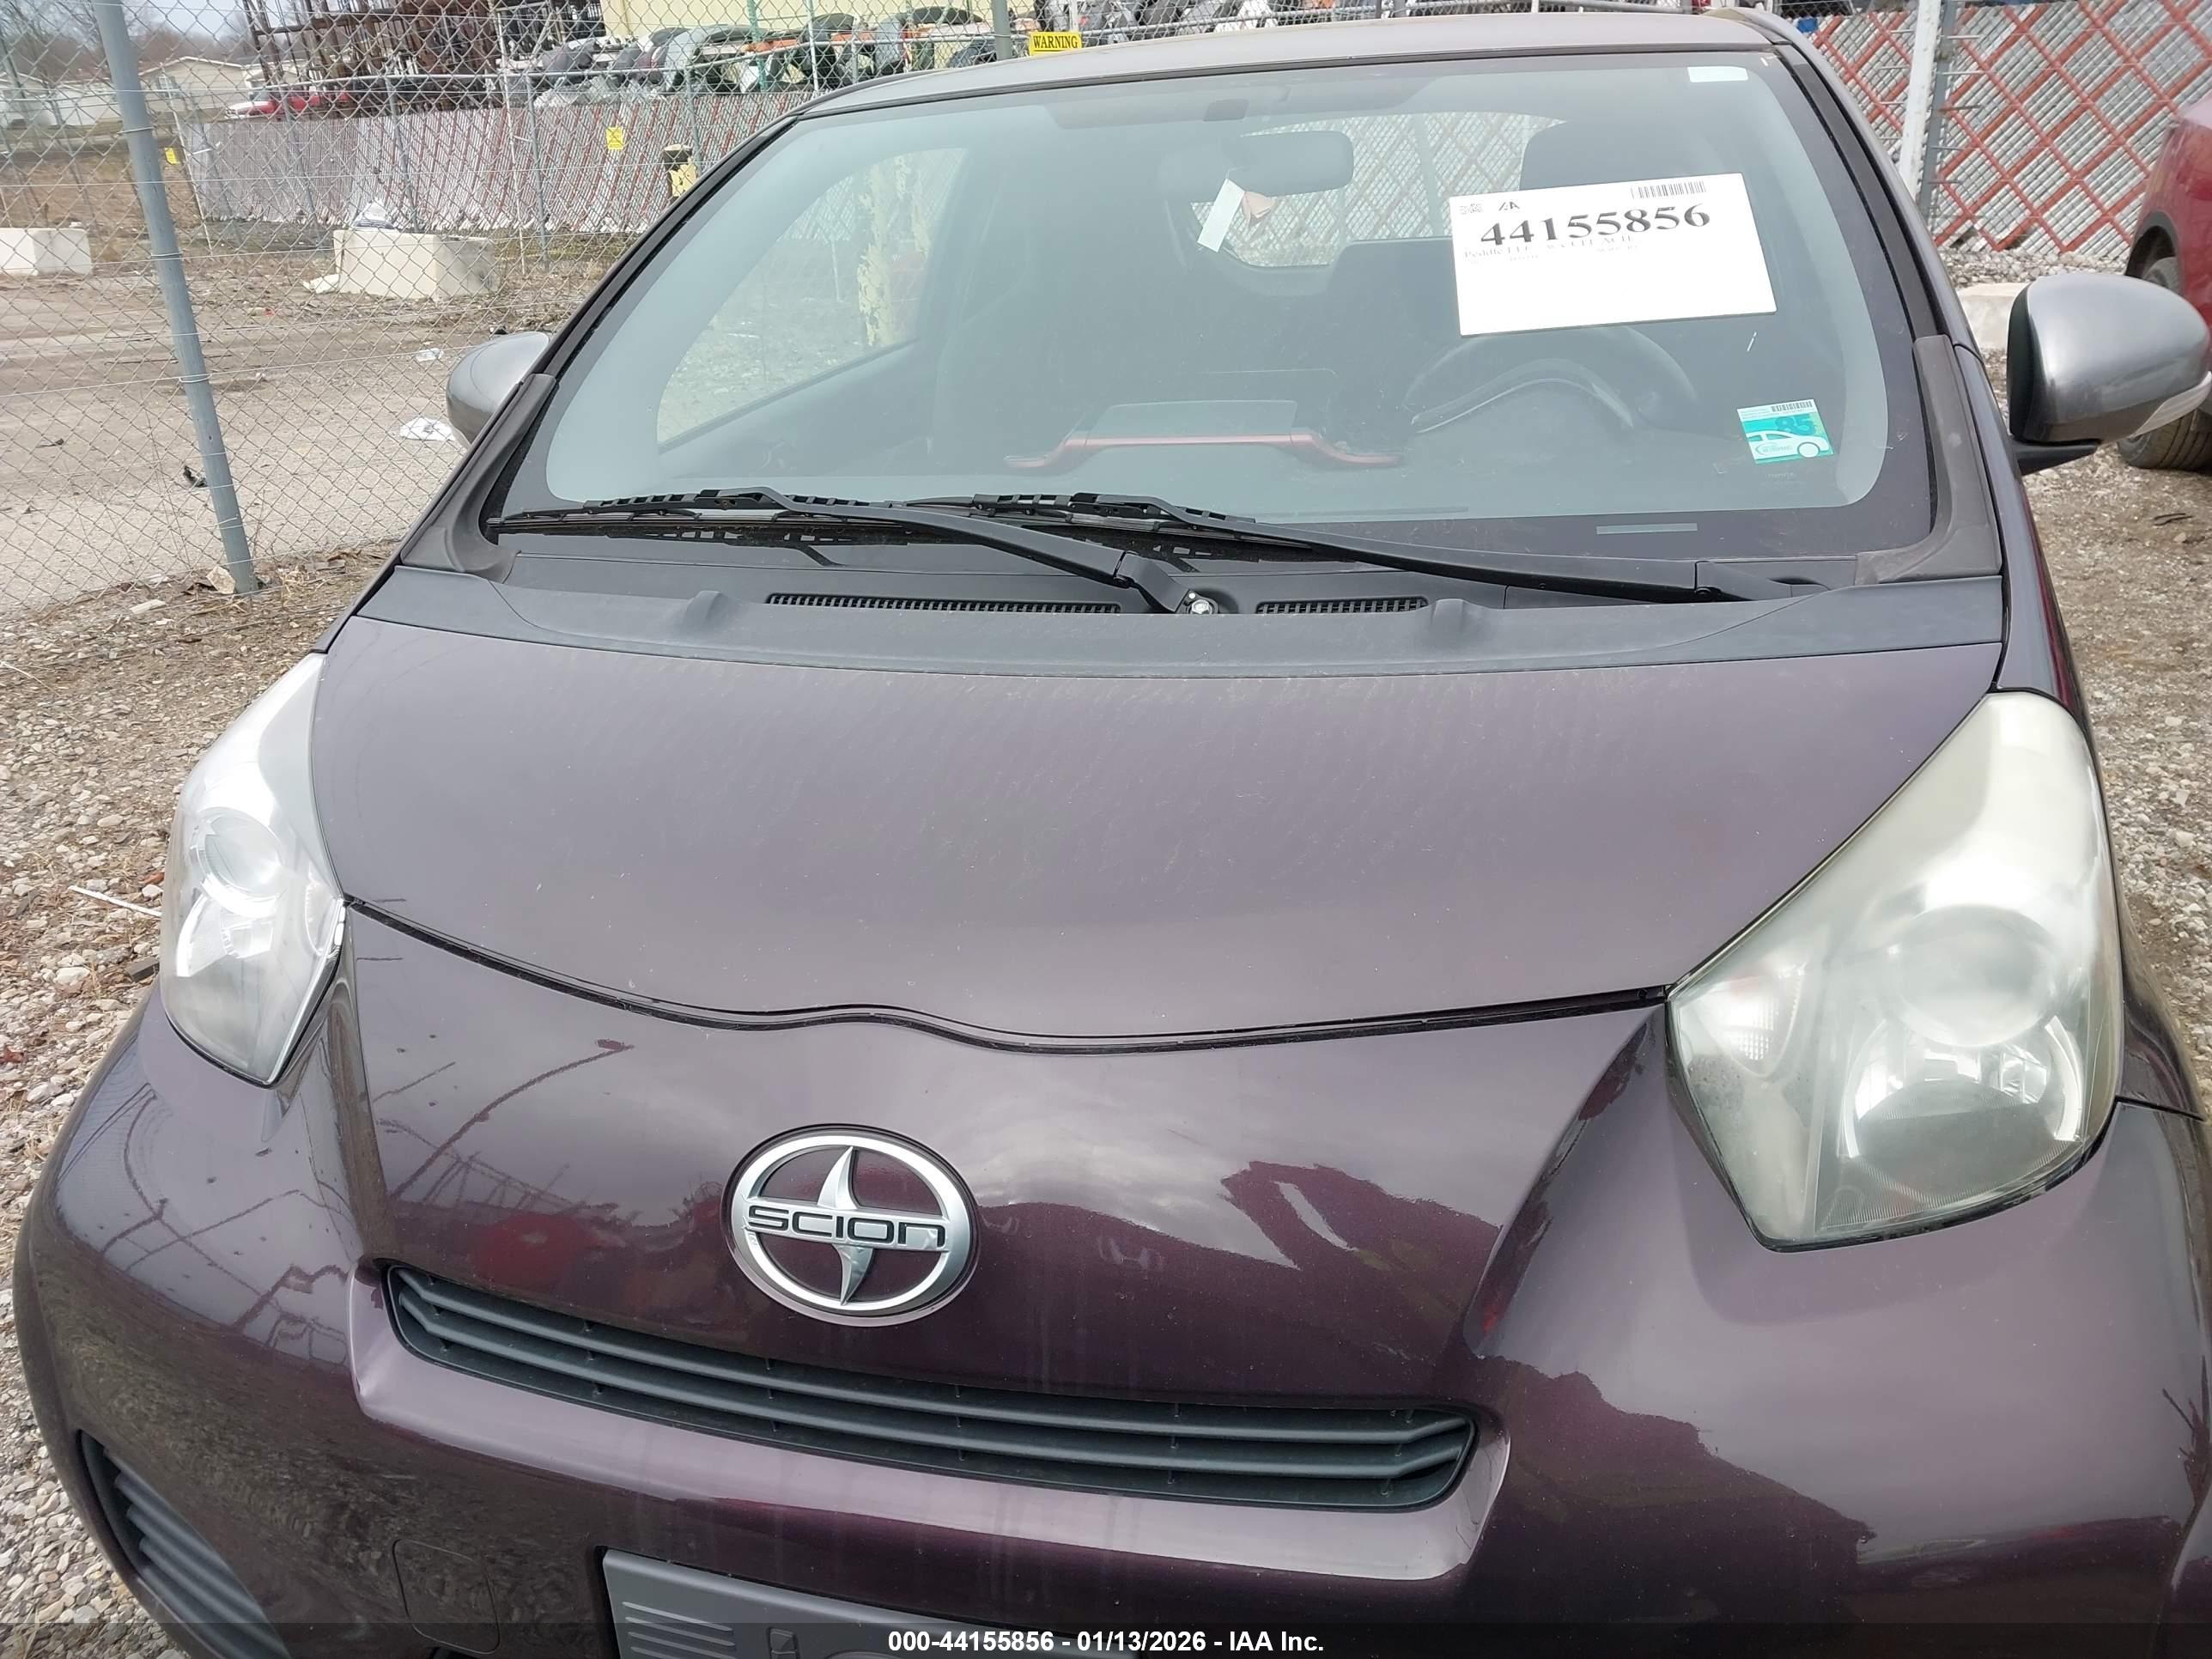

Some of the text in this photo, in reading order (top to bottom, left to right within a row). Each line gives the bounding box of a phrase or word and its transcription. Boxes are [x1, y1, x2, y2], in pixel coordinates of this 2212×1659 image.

[1033, 35, 1079, 49] WARNING
[1480, 204, 1711, 246] 44155856
[748, 1205, 945, 1248] SCION
